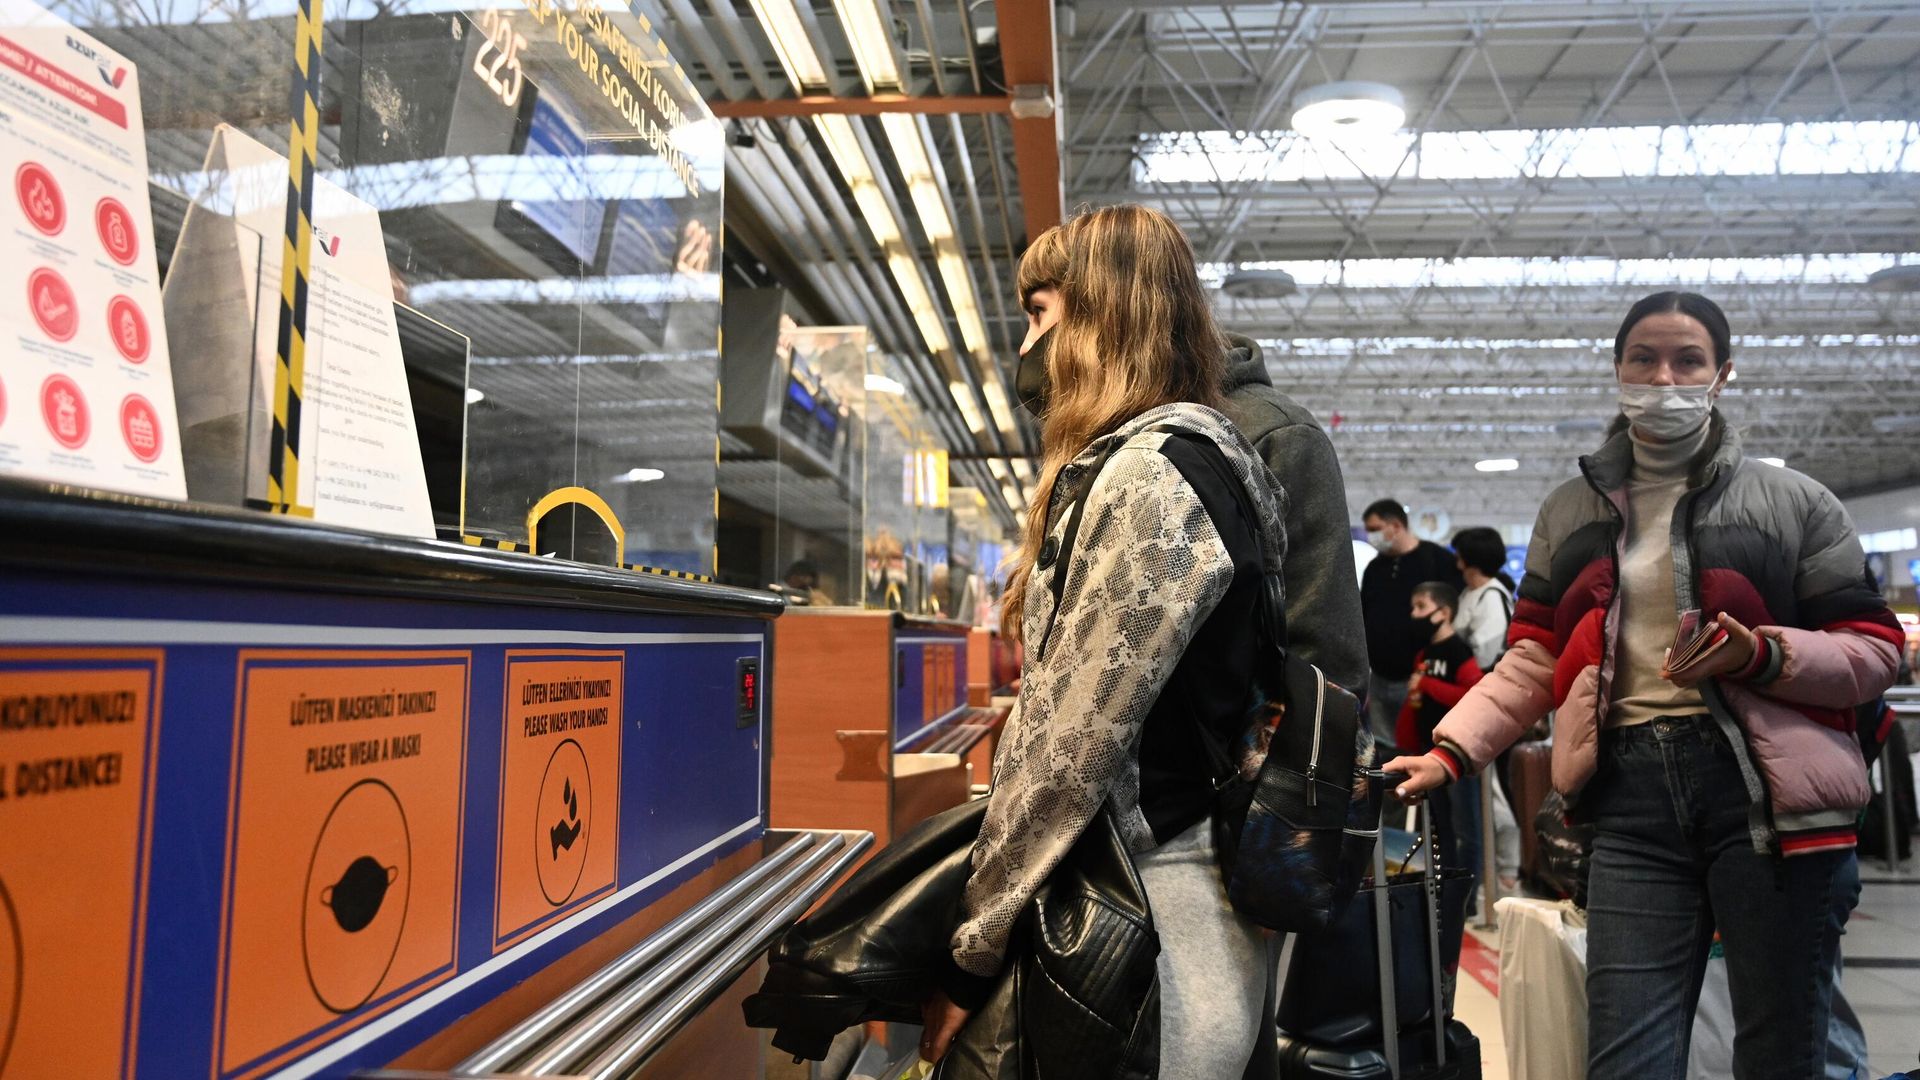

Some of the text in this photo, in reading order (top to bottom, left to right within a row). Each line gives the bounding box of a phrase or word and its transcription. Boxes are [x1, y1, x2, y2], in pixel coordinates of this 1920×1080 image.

[473, 4, 528, 107] 225
[556, 7, 599, 86] YOUR
[602, 63, 647, 141] SOCIAL
[650, 119, 699, 199] DISTANCE
[290, 692, 335, 727] LÜTFEN
[397, 690, 437, 716] TAKINIZ!
[522, 679, 548, 706] LÜTFEN
[582, 679, 612, 699] YIKAYINIZ!
[524, 706, 608, 738] PLEASE WASH YOUR HANDS!
[305, 733, 421, 774] PLEASE WEAR A MASK!
[16, 752, 122, 798] DISTANCE!
